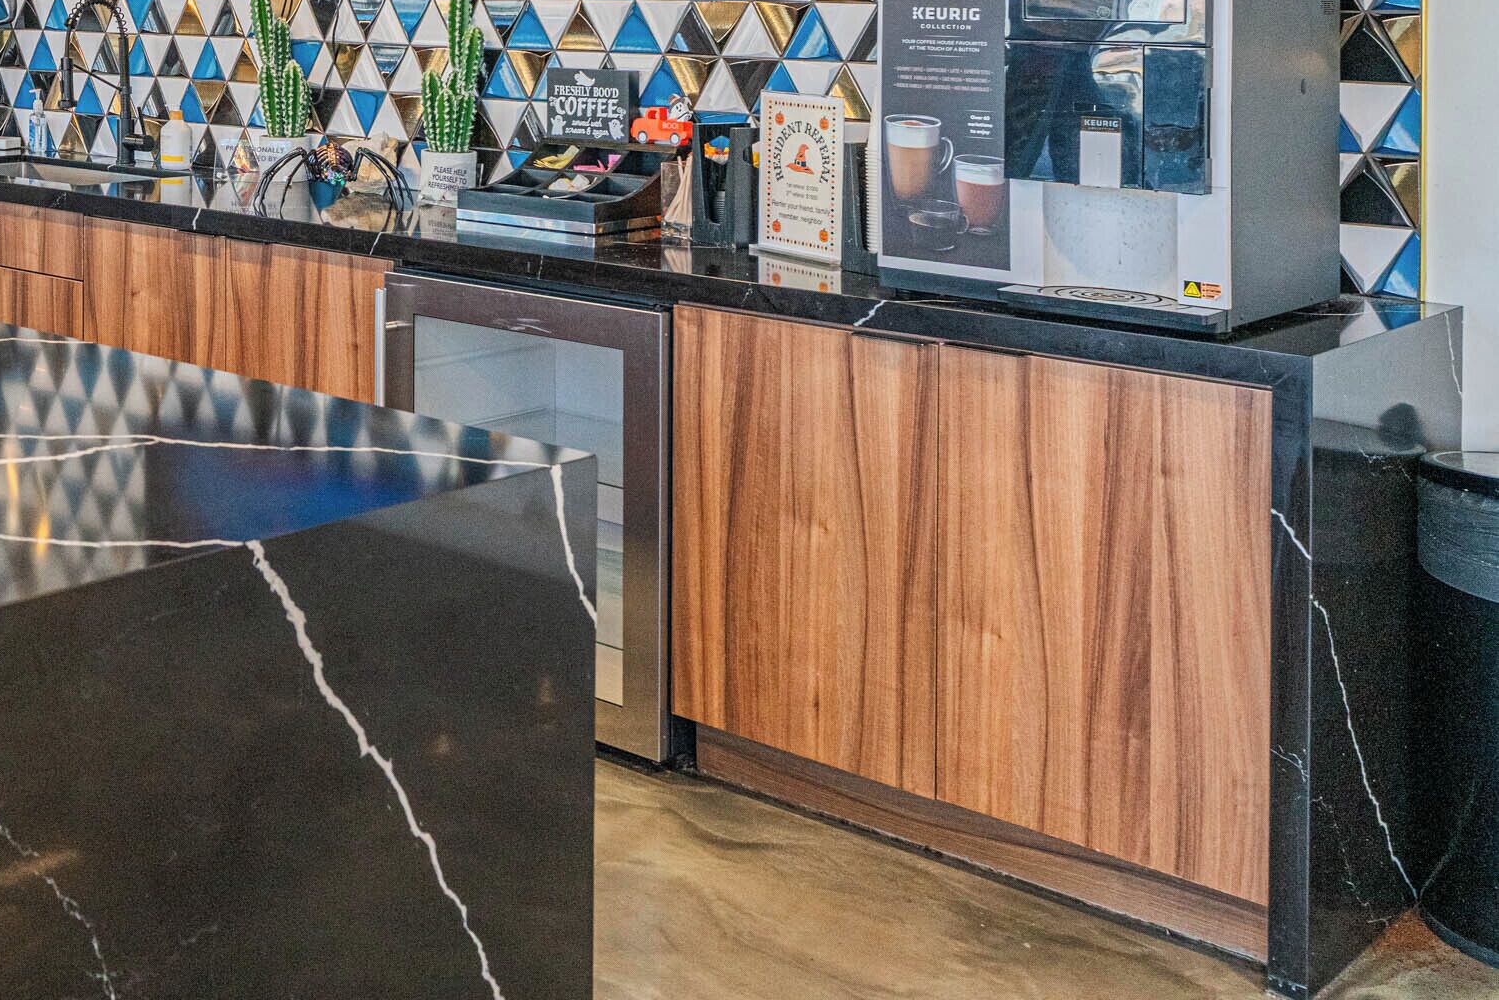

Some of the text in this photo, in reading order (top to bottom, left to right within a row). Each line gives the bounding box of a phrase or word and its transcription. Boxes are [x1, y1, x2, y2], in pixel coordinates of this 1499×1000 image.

[912, 6, 981, 21] KEURIG
[920, 23, 972, 31] COLLECTION
[554, 85, 619, 98] FRESHLY BOO'D
[554, 96, 619, 118] COFFEE
[1084, 119, 1119, 128] KEURIG
[773, 120, 803, 182] RESIDENT
[433, 165, 468, 177] PLEASE HELP
[432, 174, 468, 185] YOURSELF TO
